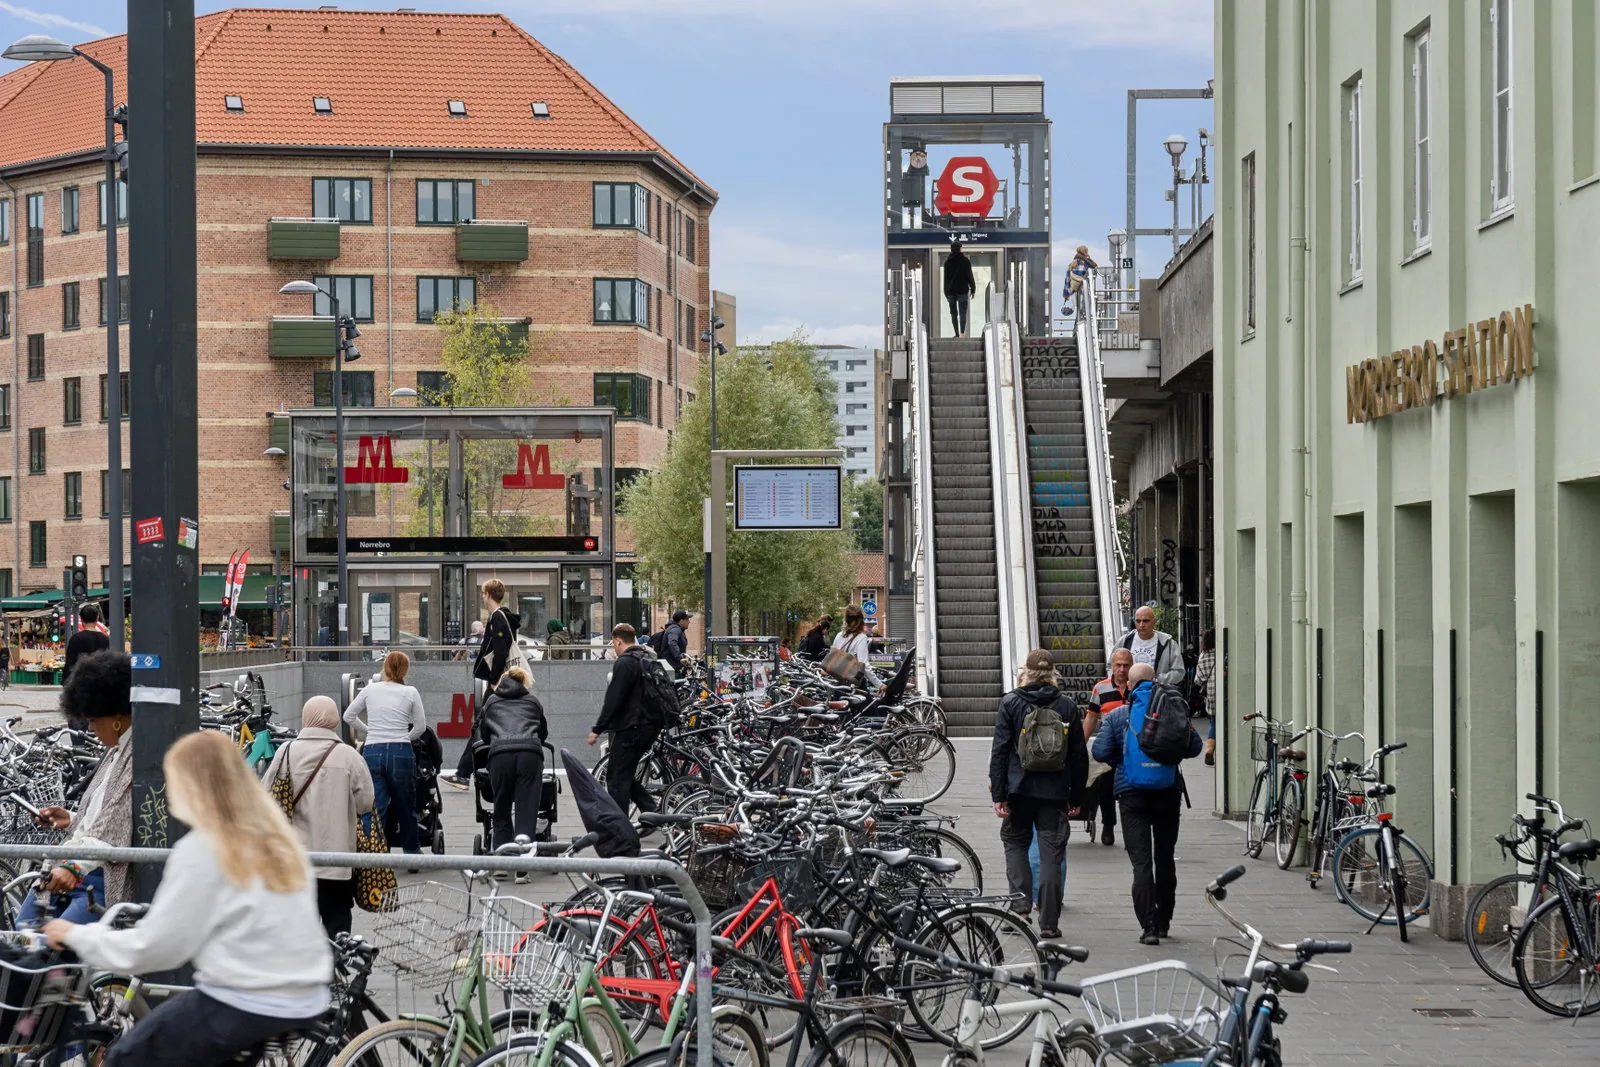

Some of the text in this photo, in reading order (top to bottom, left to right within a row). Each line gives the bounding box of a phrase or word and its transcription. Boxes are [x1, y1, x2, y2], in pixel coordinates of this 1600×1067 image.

[951, 166, 985, 202] S
[1443, 303, 1533, 399] STATION
[502, 444, 566, 489] M
[75, 556, 84, 567] S
